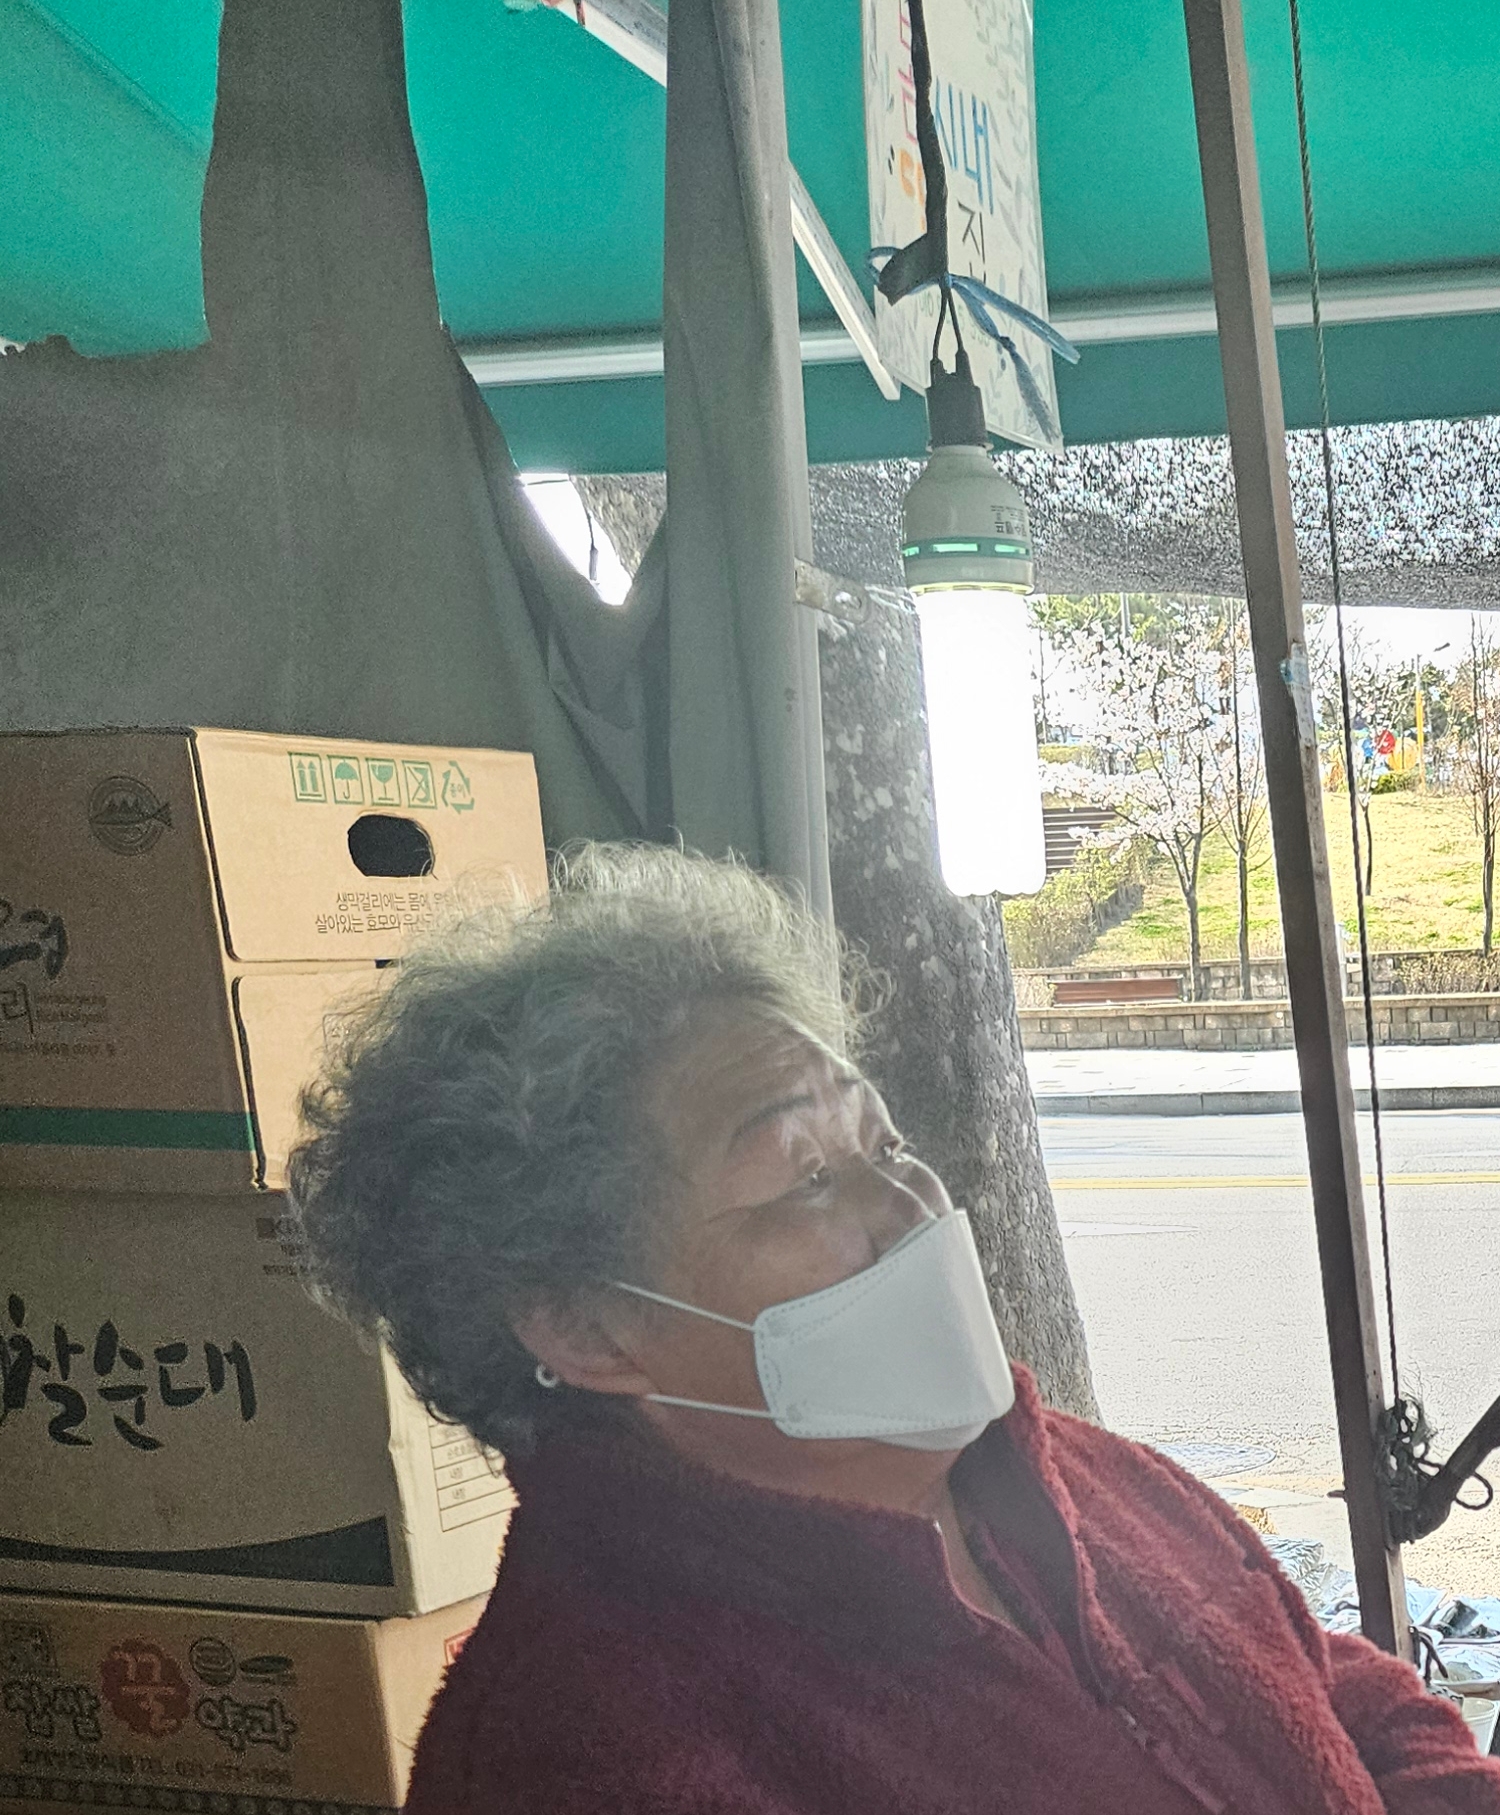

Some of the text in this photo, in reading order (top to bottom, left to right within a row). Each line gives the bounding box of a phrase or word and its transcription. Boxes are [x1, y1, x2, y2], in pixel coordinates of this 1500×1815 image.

[336, 892, 406, 912] 생막걸리에는
[315, 913, 364, 934] 살아있는
[3, 1680, 102, 1743] 찹쌀
[111, 1651, 177, 1731] 꿀
[194, 1695, 297, 1752] 약과
